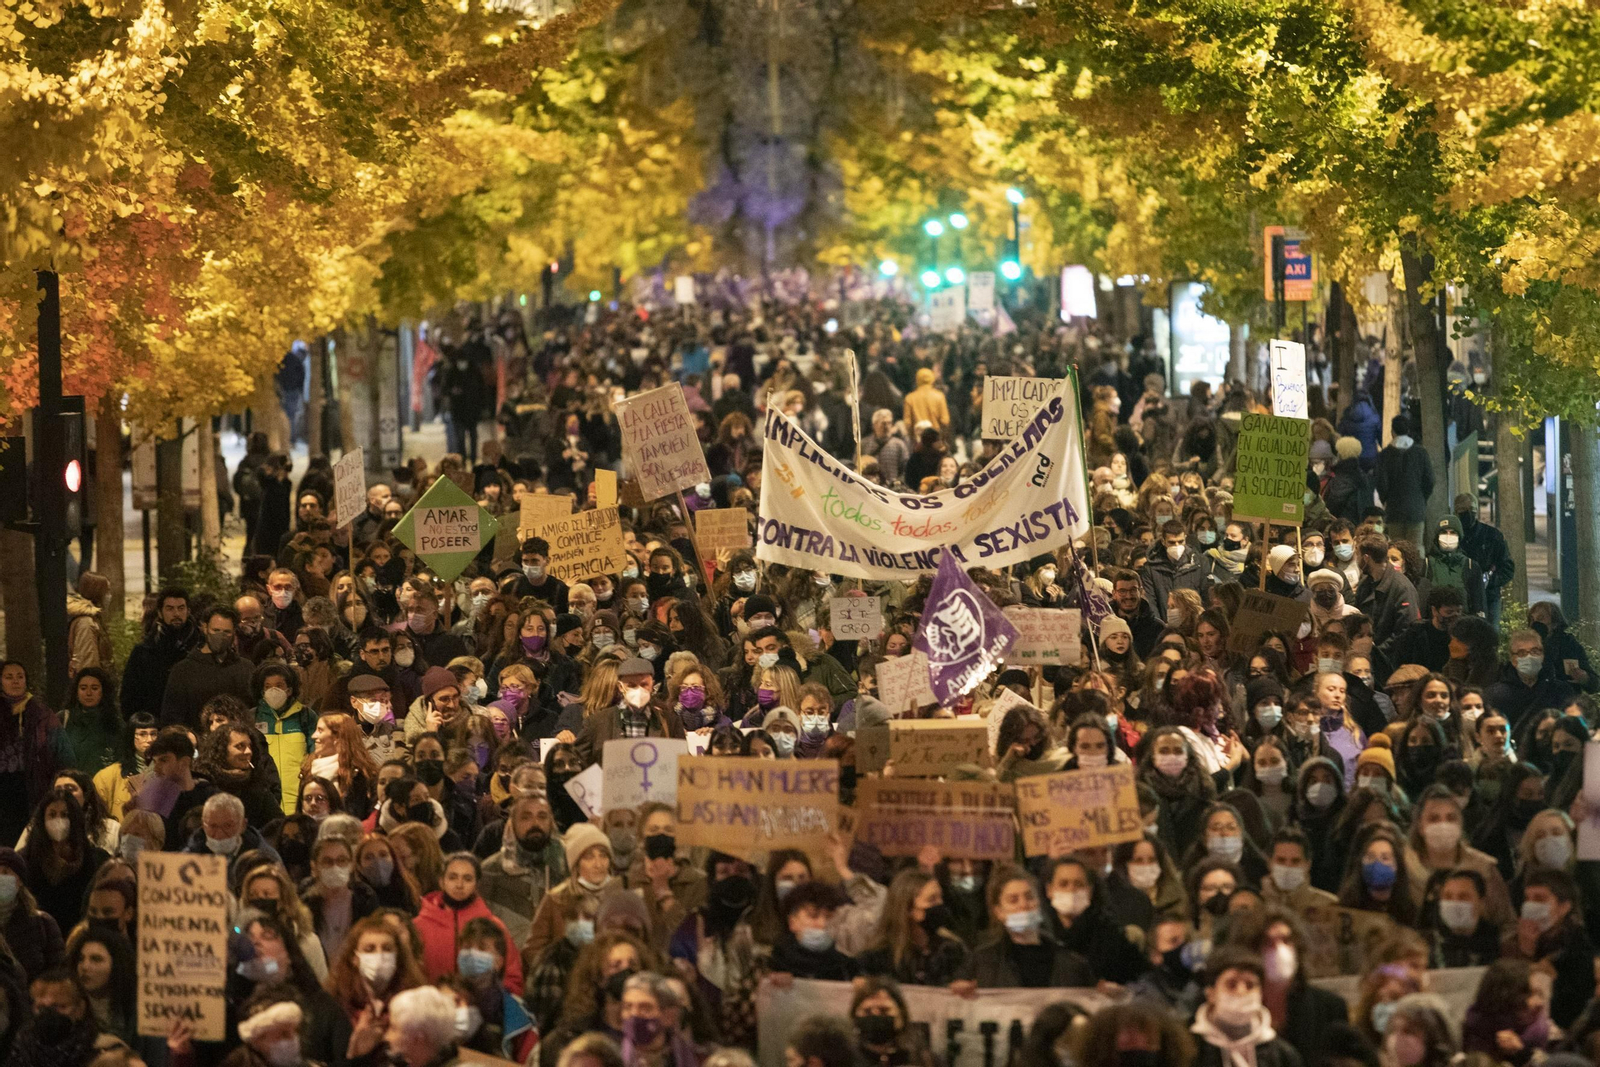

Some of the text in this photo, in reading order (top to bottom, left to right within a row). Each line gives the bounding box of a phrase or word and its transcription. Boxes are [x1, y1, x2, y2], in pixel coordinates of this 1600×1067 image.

[1285, 264, 1307, 276] AXI
[623, 395, 679, 429] LA CALLE
[1011, 403, 1029, 419] OS
[626, 414, 688, 444] Y LA FIESTA
[1242, 415, 1308, 438] GANANDO
[1239, 434, 1306, 458] EN IGUALDAD
[641, 460, 664, 479] SON
[1238, 454, 1302, 479] GANA TODA
[1233, 475, 1306, 501] LA SOCIEDAD
[899, 496, 944, 511] OS
[423, 508, 469, 525] AMAR
[430, 525, 442, 534] NO
[541, 521, 570, 538] AMIGO
[571, 518, 587, 532] DEL
[420, 536, 472, 551] POSEER
[588, 544, 601, 554] ES
[839, 540, 861, 564] LA
[847, 598, 860, 608] YO
[841, 623, 870, 634] CREO
[680, 767, 711, 790] NO
[717, 768, 764, 794] HAN
[1020, 783, 1042, 799] TE
[144, 861, 165, 882] TU
[143, 913, 222, 935] ALIMENTA
[142, 937, 160, 954] LA
[143, 960, 151, 978] Y
[156, 962, 176, 978] LA
